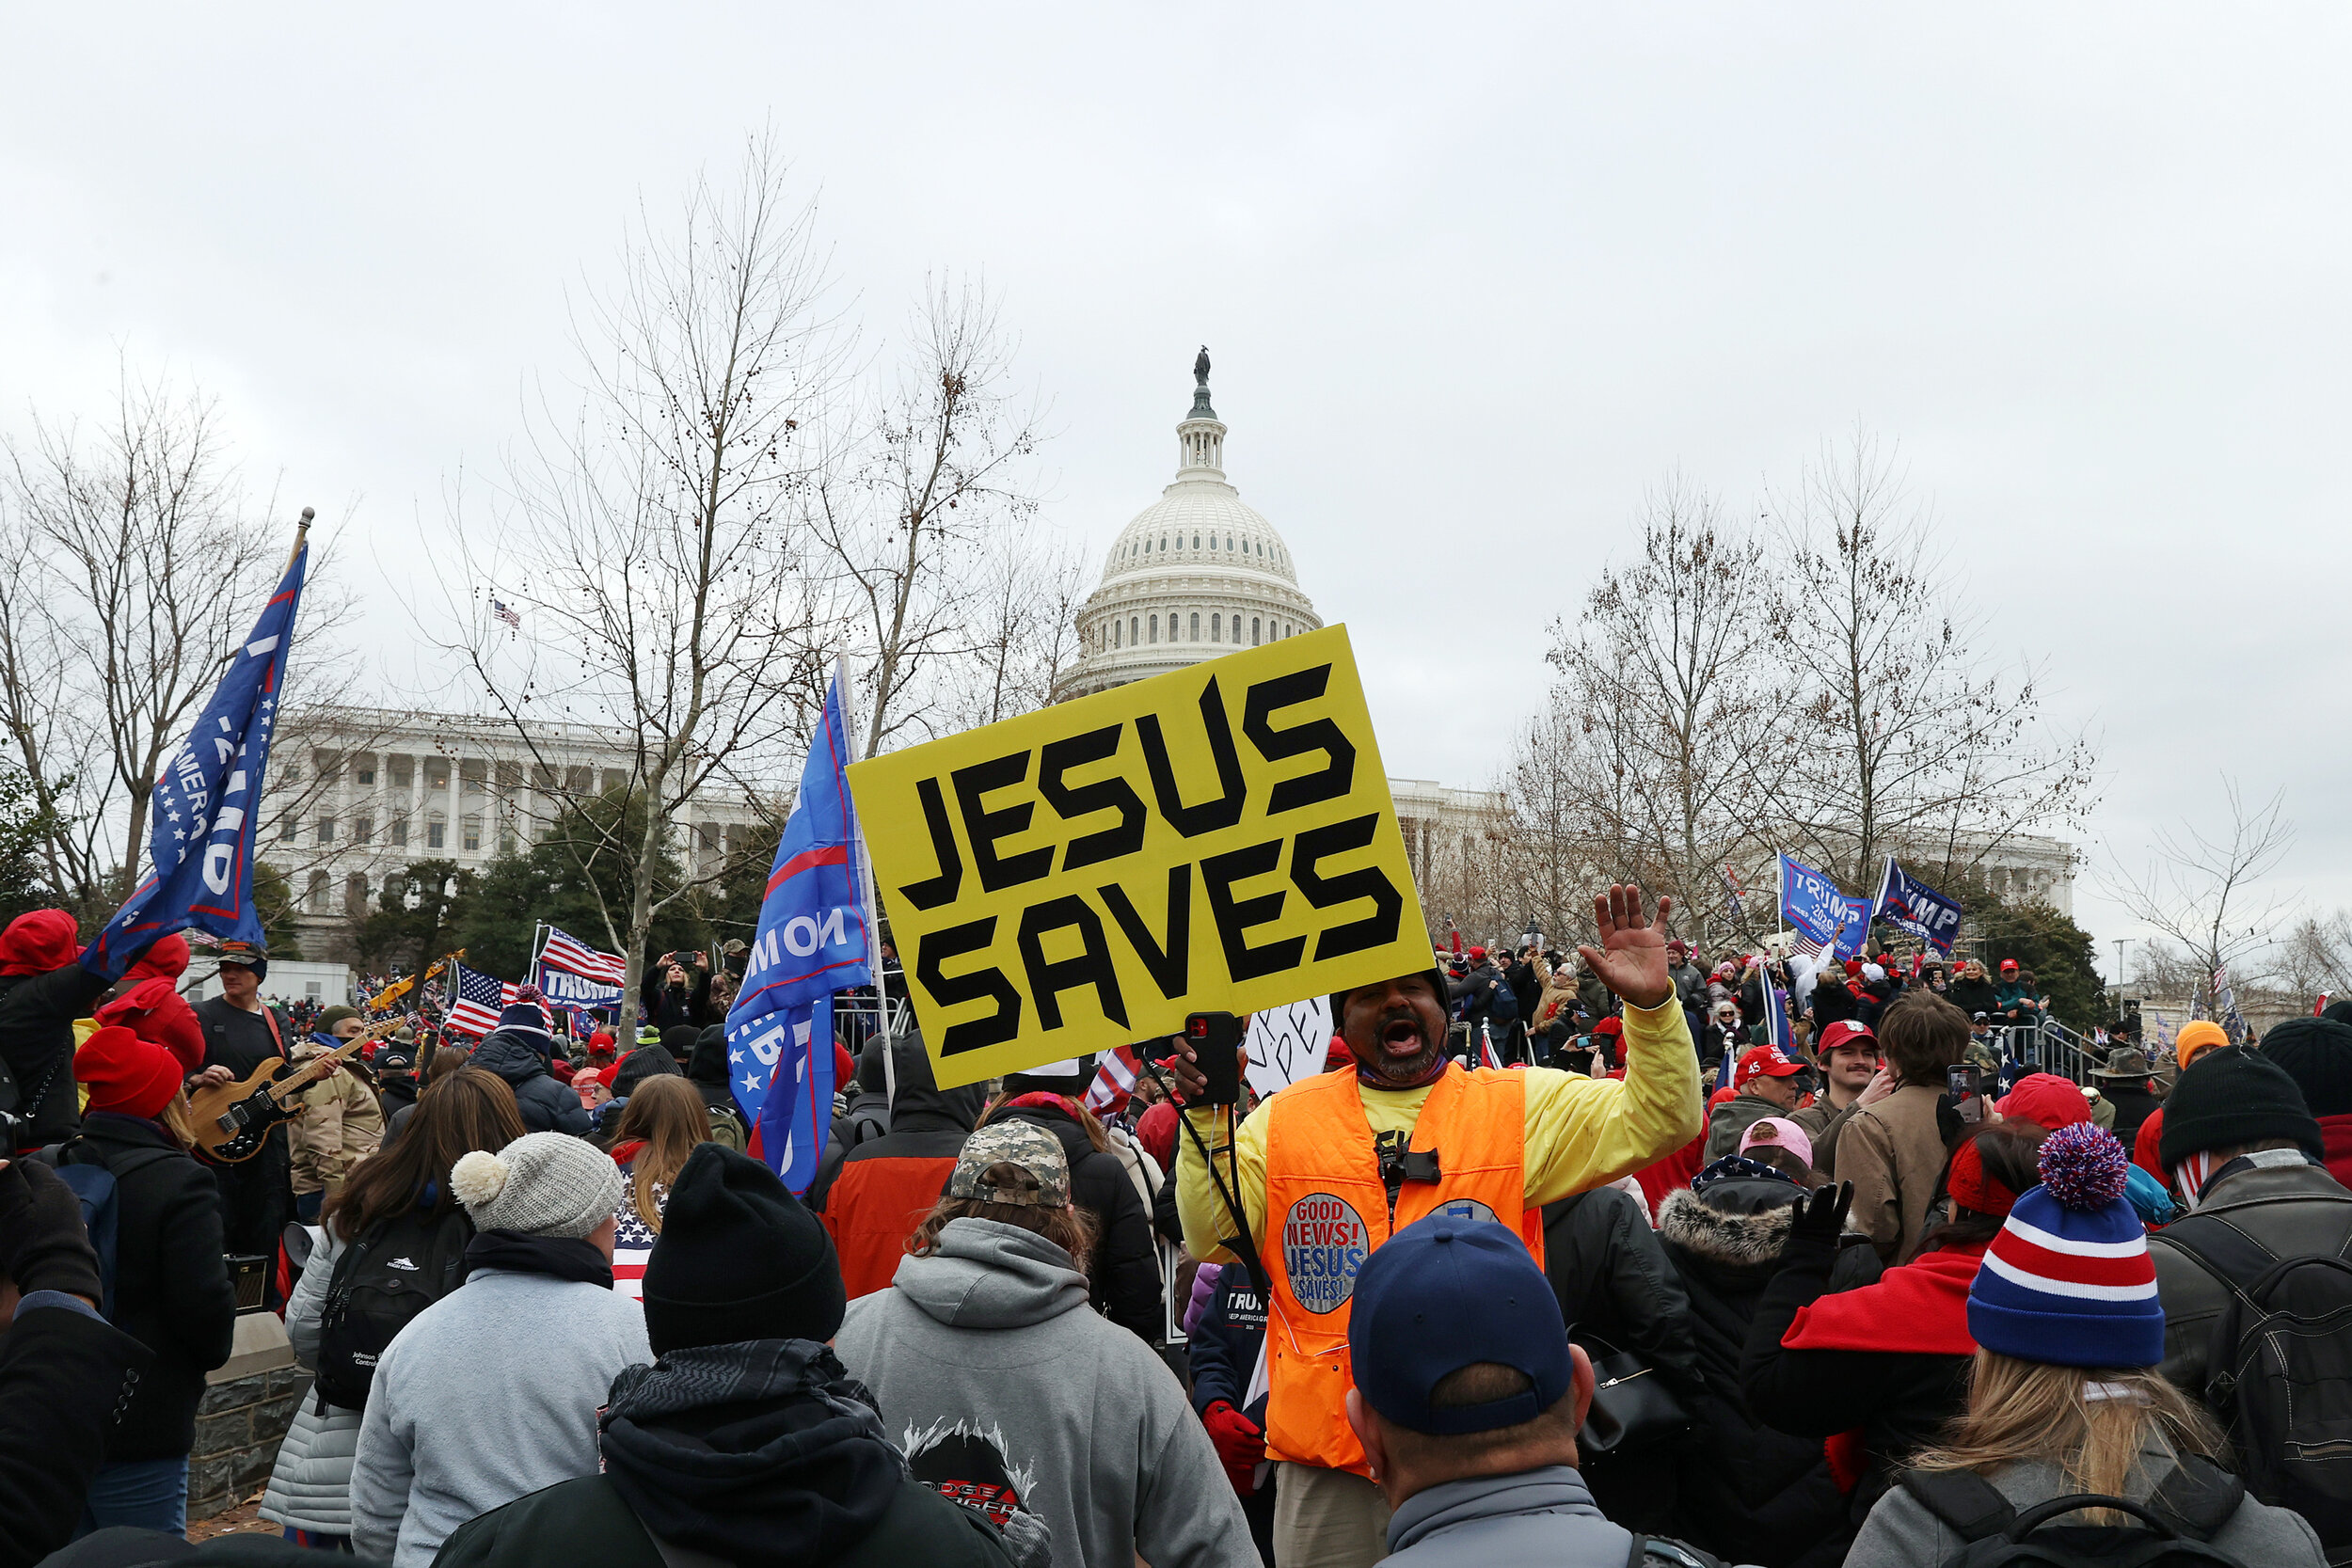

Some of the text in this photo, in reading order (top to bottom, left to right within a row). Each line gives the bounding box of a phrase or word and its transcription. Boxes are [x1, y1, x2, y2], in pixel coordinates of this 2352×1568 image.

[898, 662, 1357, 911] JESUS
[1795, 872, 1860, 924] TRUMP
[916, 812, 1404, 1058] SAVES
[1809, 916, 1833, 940] AMERICA
[1836, 939, 1852, 954] REAT!
[1748, 1060, 1761, 1074] 45
[1296, 1201, 1343, 1221] GOOD
[1287, 1223, 1359, 1246] NEWS!
[1289, 1248, 1364, 1277] JESUS
[1298, 1280, 1343, 1300] SAVES!
[352, 1351, 375, 1361] Johnson
[355, 1358, 377, 1368] Control
[918, 1481, 995, 1498] ODGE
